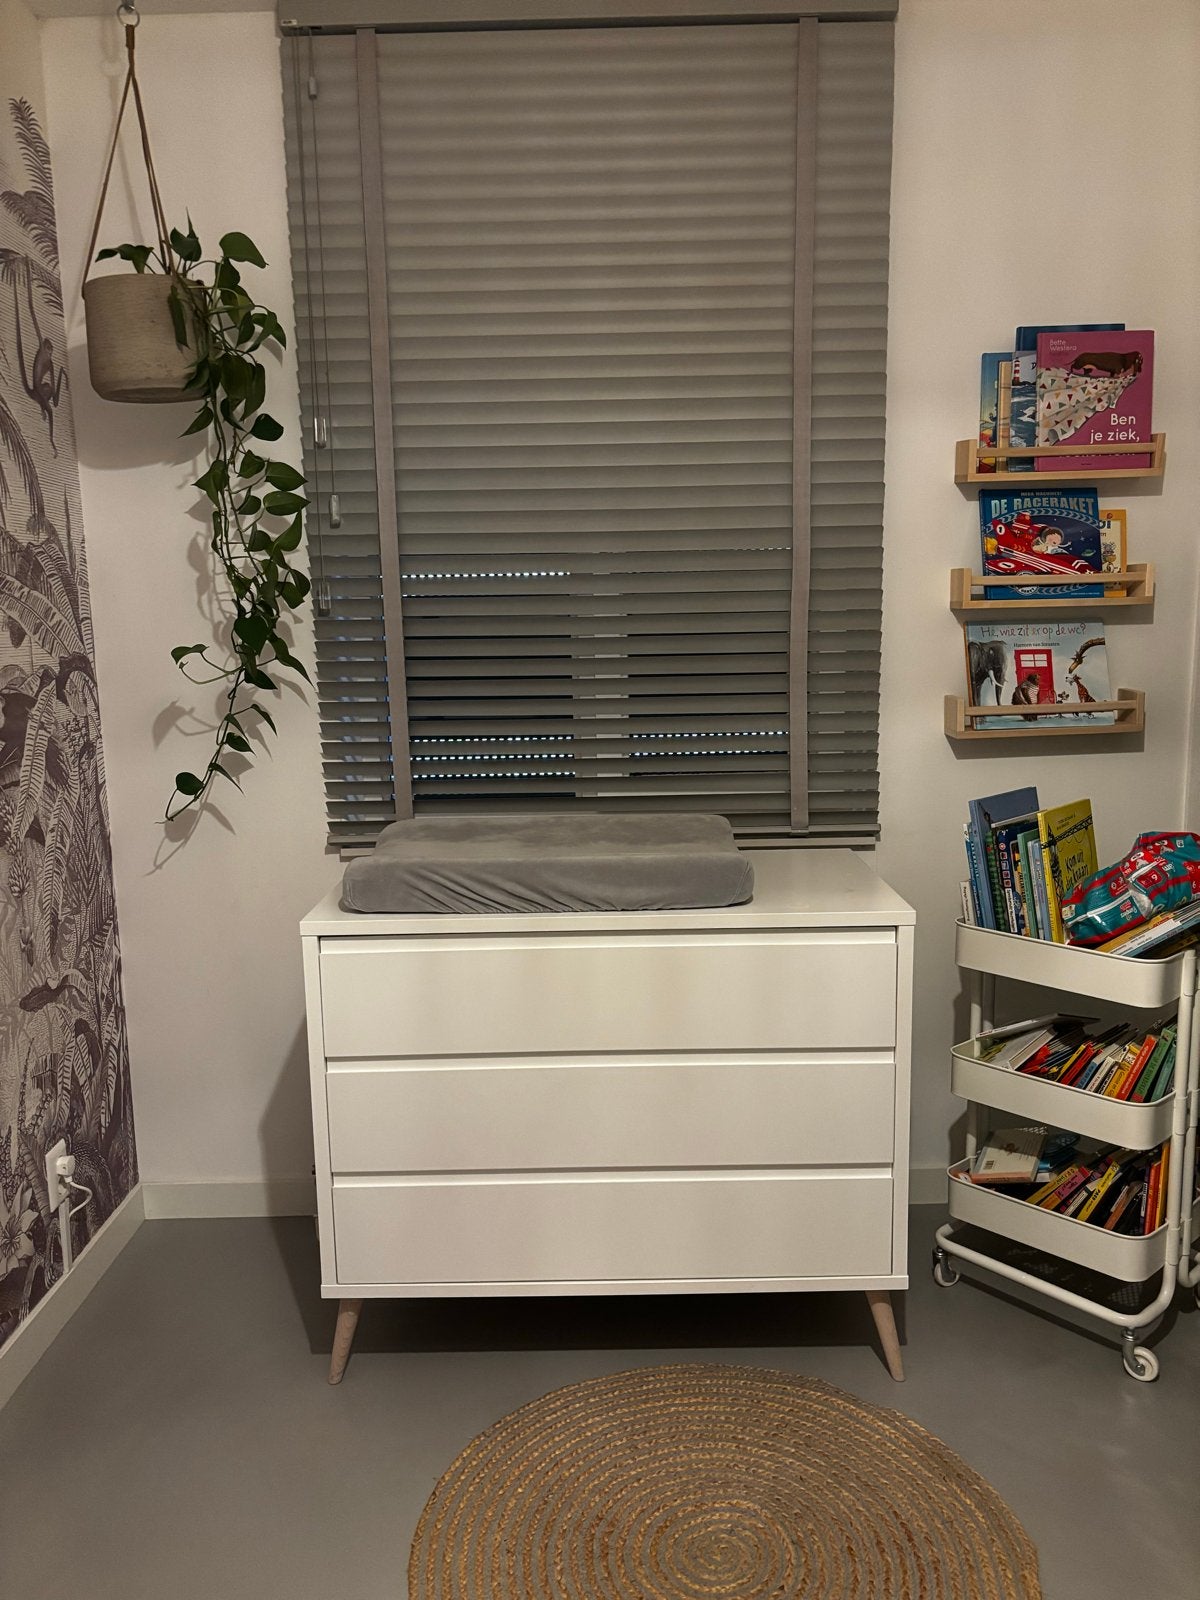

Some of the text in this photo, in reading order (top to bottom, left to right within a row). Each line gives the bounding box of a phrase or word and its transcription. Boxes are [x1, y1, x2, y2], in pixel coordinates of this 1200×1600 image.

[1110, 413, 1136, 425] Ben
[1090, 428, 1140, 444] je ziek,
[991, 497, 1094, 518] DE RACERAKET
[1000, 628, 1016, 637] wie
[1017, 624, 1029, 637] zit
[1032, 627, 1041, 637] er
[1042, 627, 1054, 639] op
[1055, 623, 1067, 636] de
[1068, 622, 1086, 635] wc?
